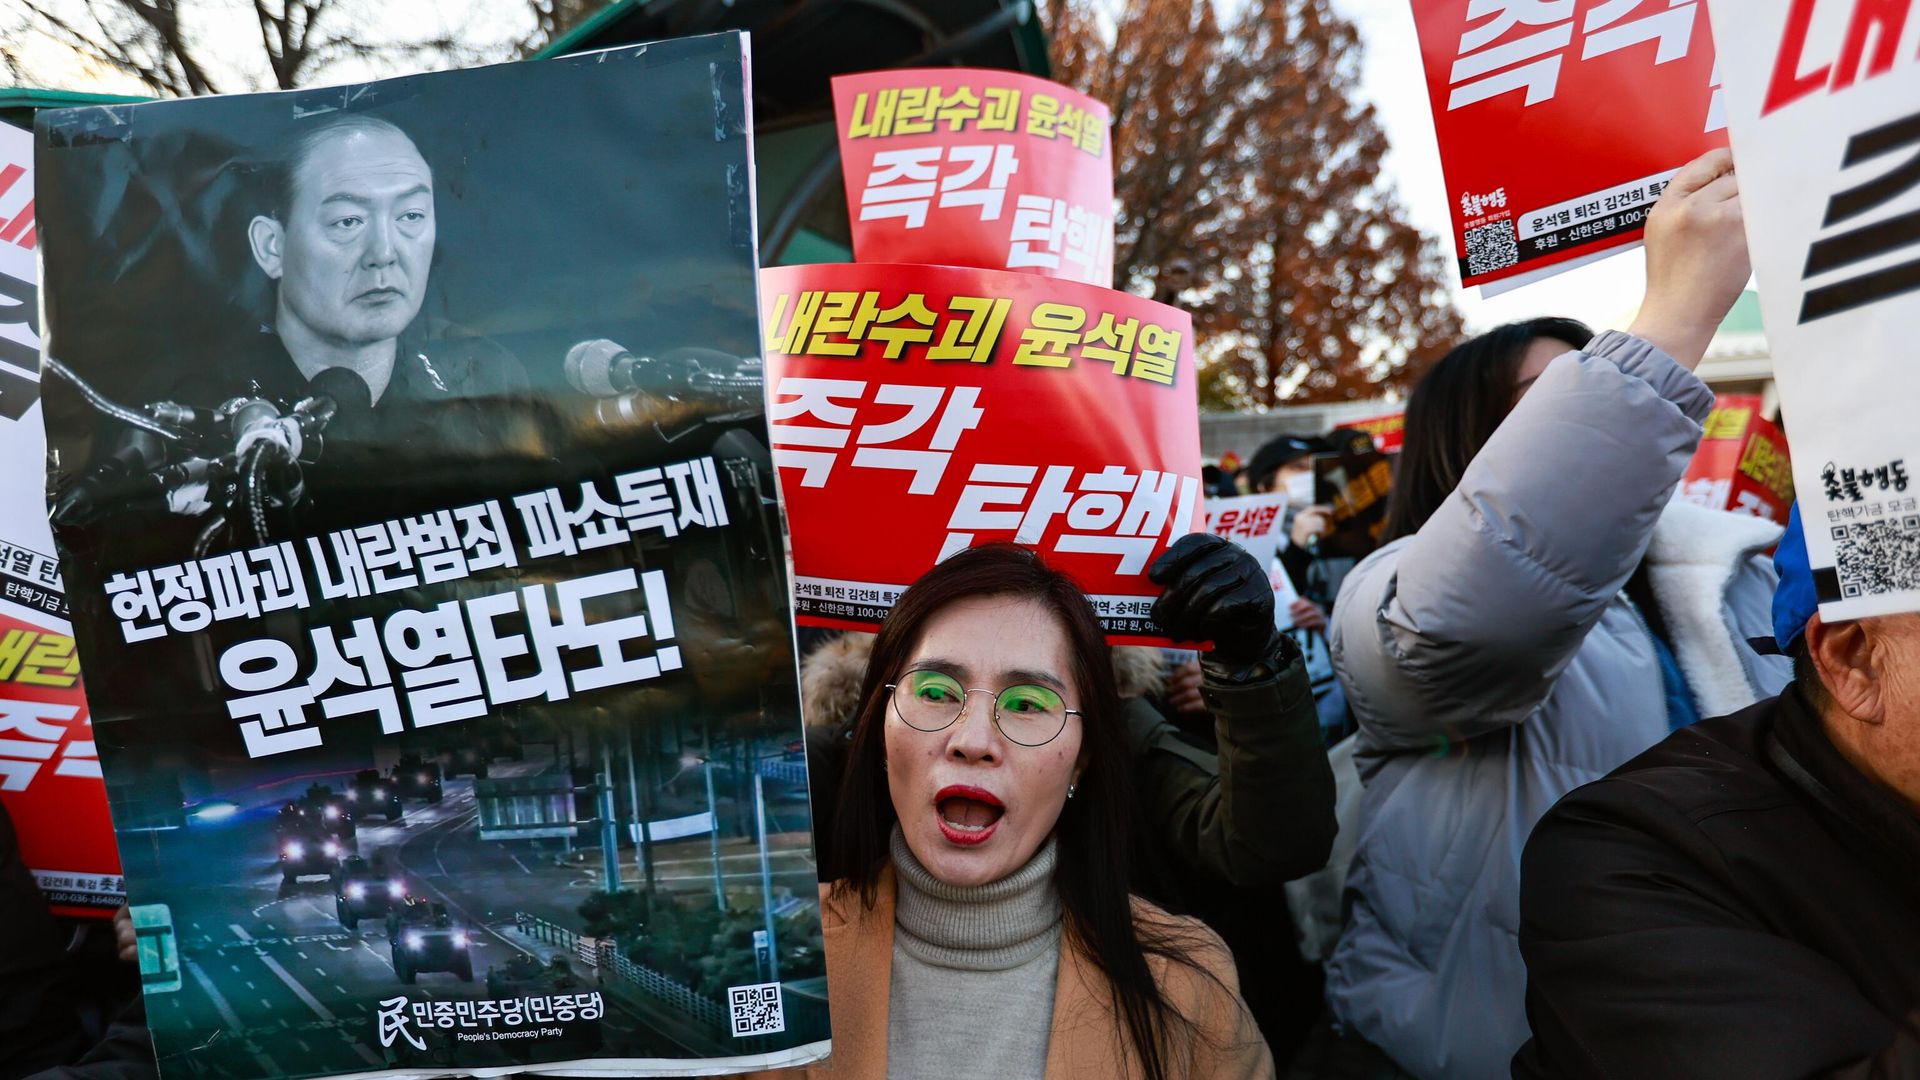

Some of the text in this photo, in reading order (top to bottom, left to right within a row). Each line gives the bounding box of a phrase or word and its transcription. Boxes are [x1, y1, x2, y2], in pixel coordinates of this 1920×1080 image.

[848, 86, 1105, 157] 내란수괴 윤석열
[859, 144, 1019, 229] 즉각
[1460, 187, 1507, 216] 촛불행동
[1532, 210, 1570, 232] 윤석열
[1574, 200, 1600, 219] 퇴진
[1604, 187, 1645, 211] 김건희
[1534, 234, 1558, 250] 후원
[1569, 216, 1615, 241] 신한은행
[766, 291, 1181, 385] 내란수괴 윤석열
[771, 377, 985, 496] 즉각
[1821, 459, 1909, 502] 촛불행동
[935, 463, 1198, 575] 탄핵!
[1827, 498, 1916, 522] 탄핵기금 모금
[104, 455, 730, 644] 헌정파괴 내란범죄 파쇼독재
[5, 582, 60, 612] 탄핵기금
[819, 602, 855, 616] 신한은행
[825, 586, 845, 599] 퇴진
[848, 589, 879, 602] 김건희
[1112, 621, 1126, 630] 1만
[1129, 621, 1142, 632] 원,
[218, 569, 684, 759] 윤석열타도!
[377, 996, 427, 1050] 民
[412, 992, 604, 1028] 민중민주당(민중당)
[457, 1028, 563, 1042] People's Democracy Party
